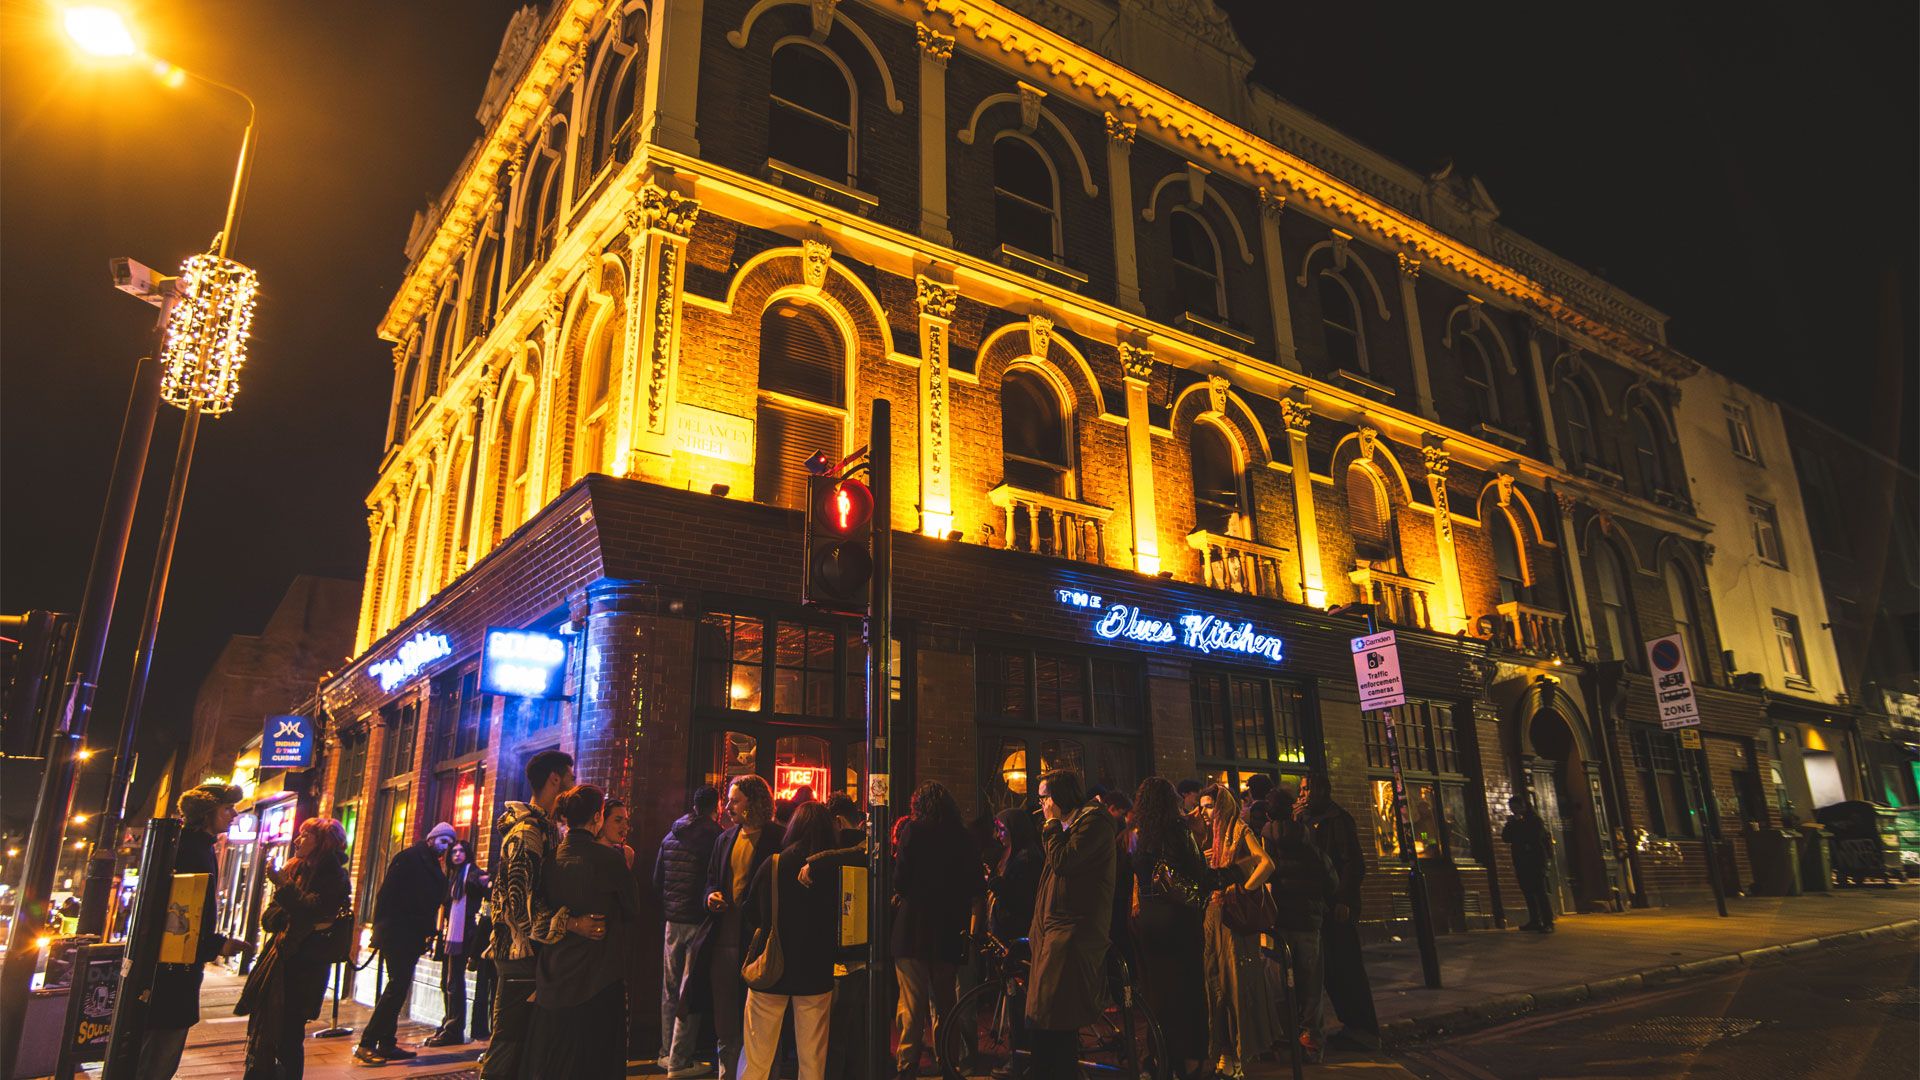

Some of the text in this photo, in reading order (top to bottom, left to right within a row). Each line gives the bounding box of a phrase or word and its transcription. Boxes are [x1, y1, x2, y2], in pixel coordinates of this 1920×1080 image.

[677, 415, 748, 443] DELANCEY
[677, 434, 724, 454] STREET
[1058, 590, 1102, 609] THE
[1096, 605, 1283, 661] Blues Kitchen
[1365, 635, 1391, 646] Camden
[1368, 670, 1389, 680] Traffic
[1360, 676, 1400, 689] enforcement
[1368, 686, 1394, 696] cameras
[1664, 703, 1693, 716] ZONE
